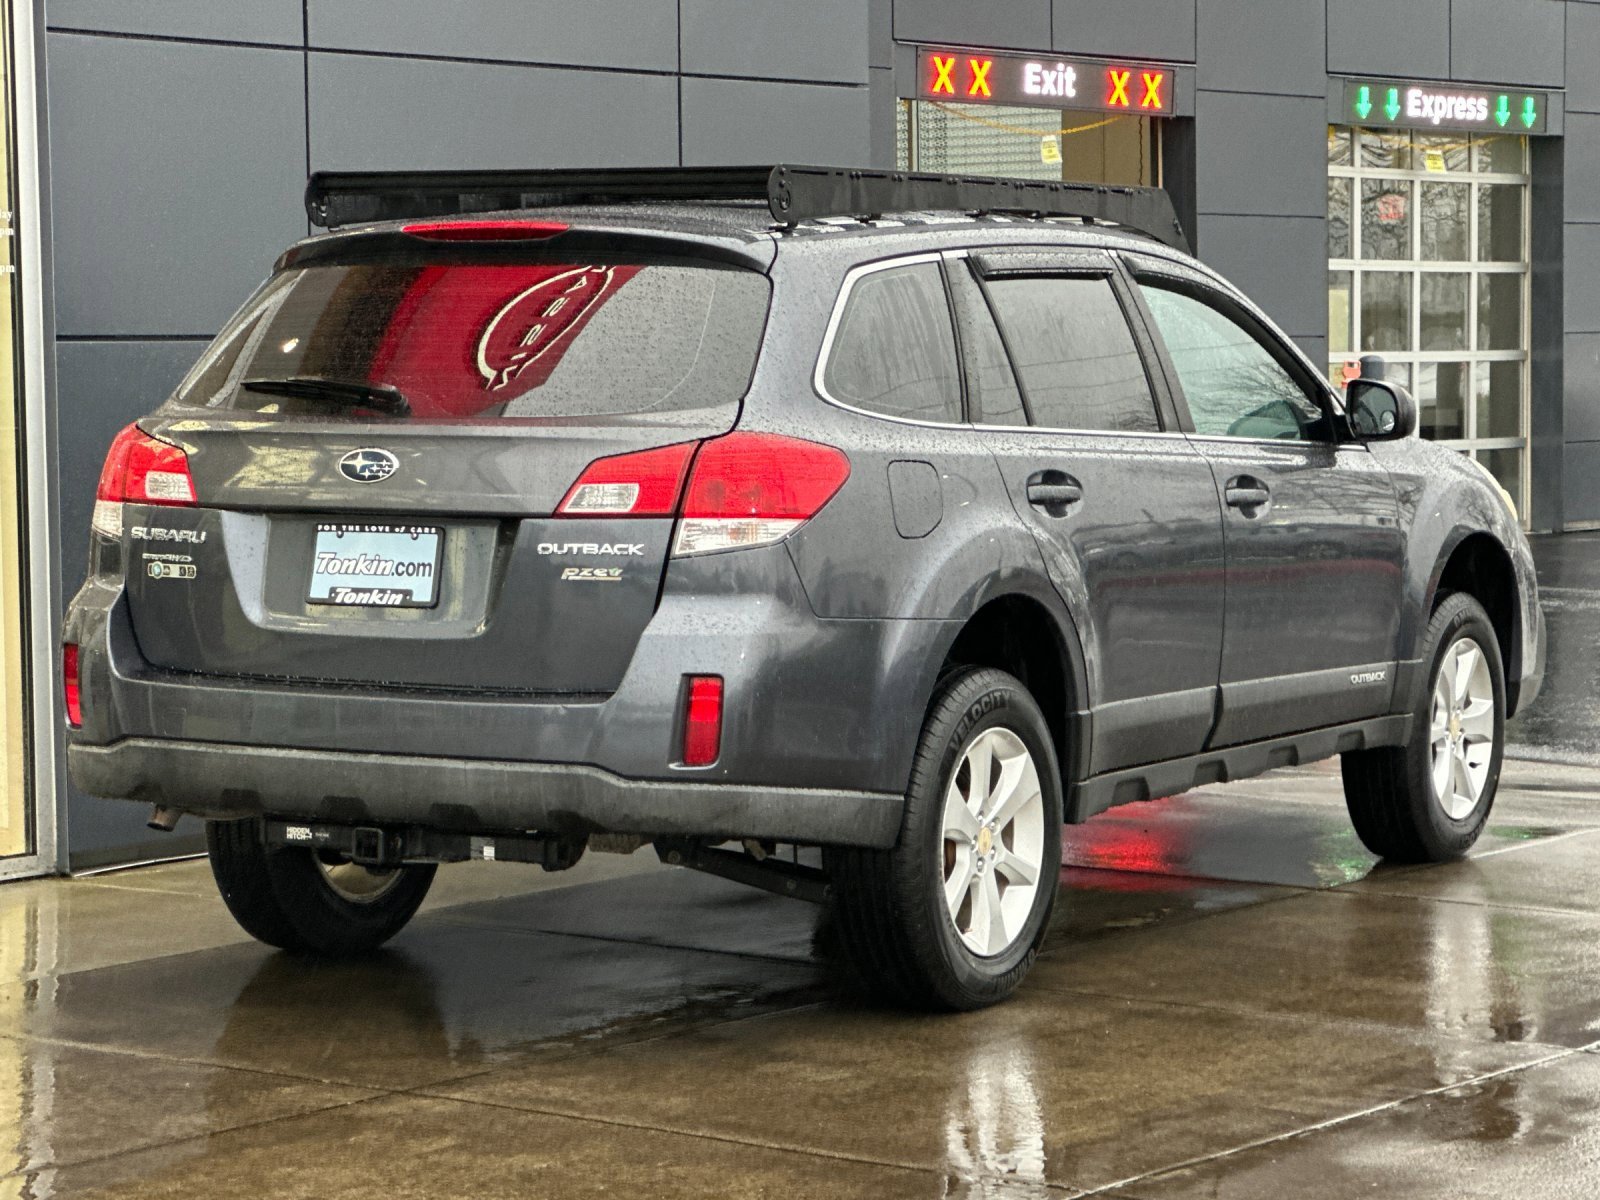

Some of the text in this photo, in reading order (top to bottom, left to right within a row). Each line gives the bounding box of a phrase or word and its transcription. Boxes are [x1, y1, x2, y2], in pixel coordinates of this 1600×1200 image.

[1023, 62, 1077, 98] Exit
[1406, 88, 1489, 125] Express
[131, 526, 207, 543] SUBARU
[317, 524, 337, 532] FOR
[365, 525, 390, 533] LOVE
[537, 542, 645, 556] OUTBACK
[316, 552, 433, 577] Tonkin.com
[335, 587, 403, 605] Tonkin
[1350, 671, 1386, 684] OUTBACK
